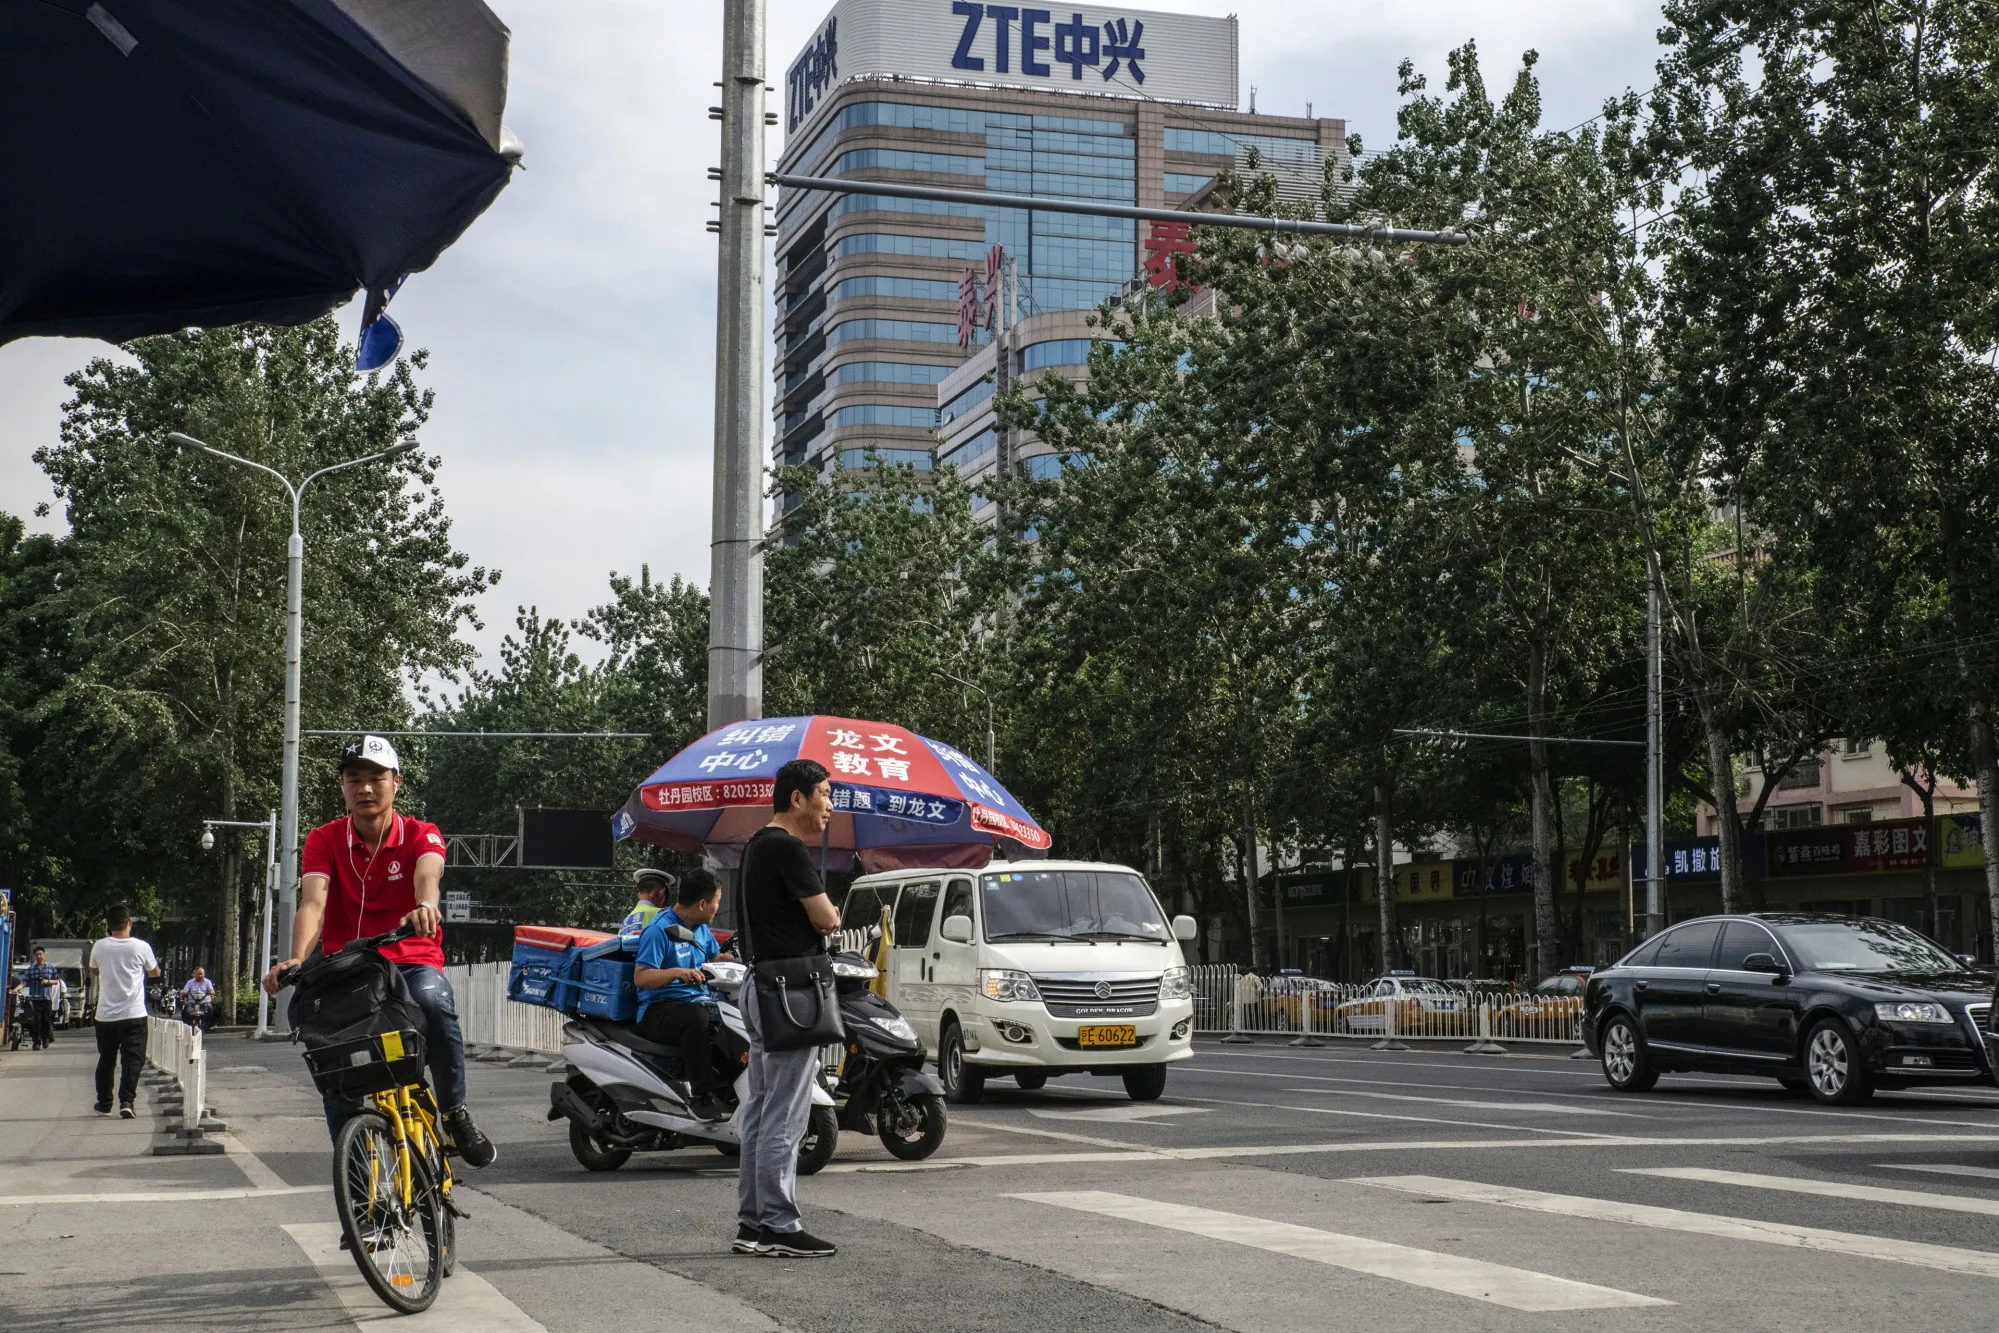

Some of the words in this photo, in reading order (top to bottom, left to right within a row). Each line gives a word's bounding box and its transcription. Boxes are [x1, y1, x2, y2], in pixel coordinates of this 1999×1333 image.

[952, 1, 1146, 86] ZTE中兴
[789, 15, 838, 135] ZTE中兴
[717, 724, 797, 746] 纠错
[826, 729, 908, 756] 龙文
[699, 748, 769, 773] 中心
[832, 751, 911, 781] 教育
[831, 788, 872, 809] 错题
[887, 794, 947, 820] 到龙文
[958, 771, 1006, 807] 中心
